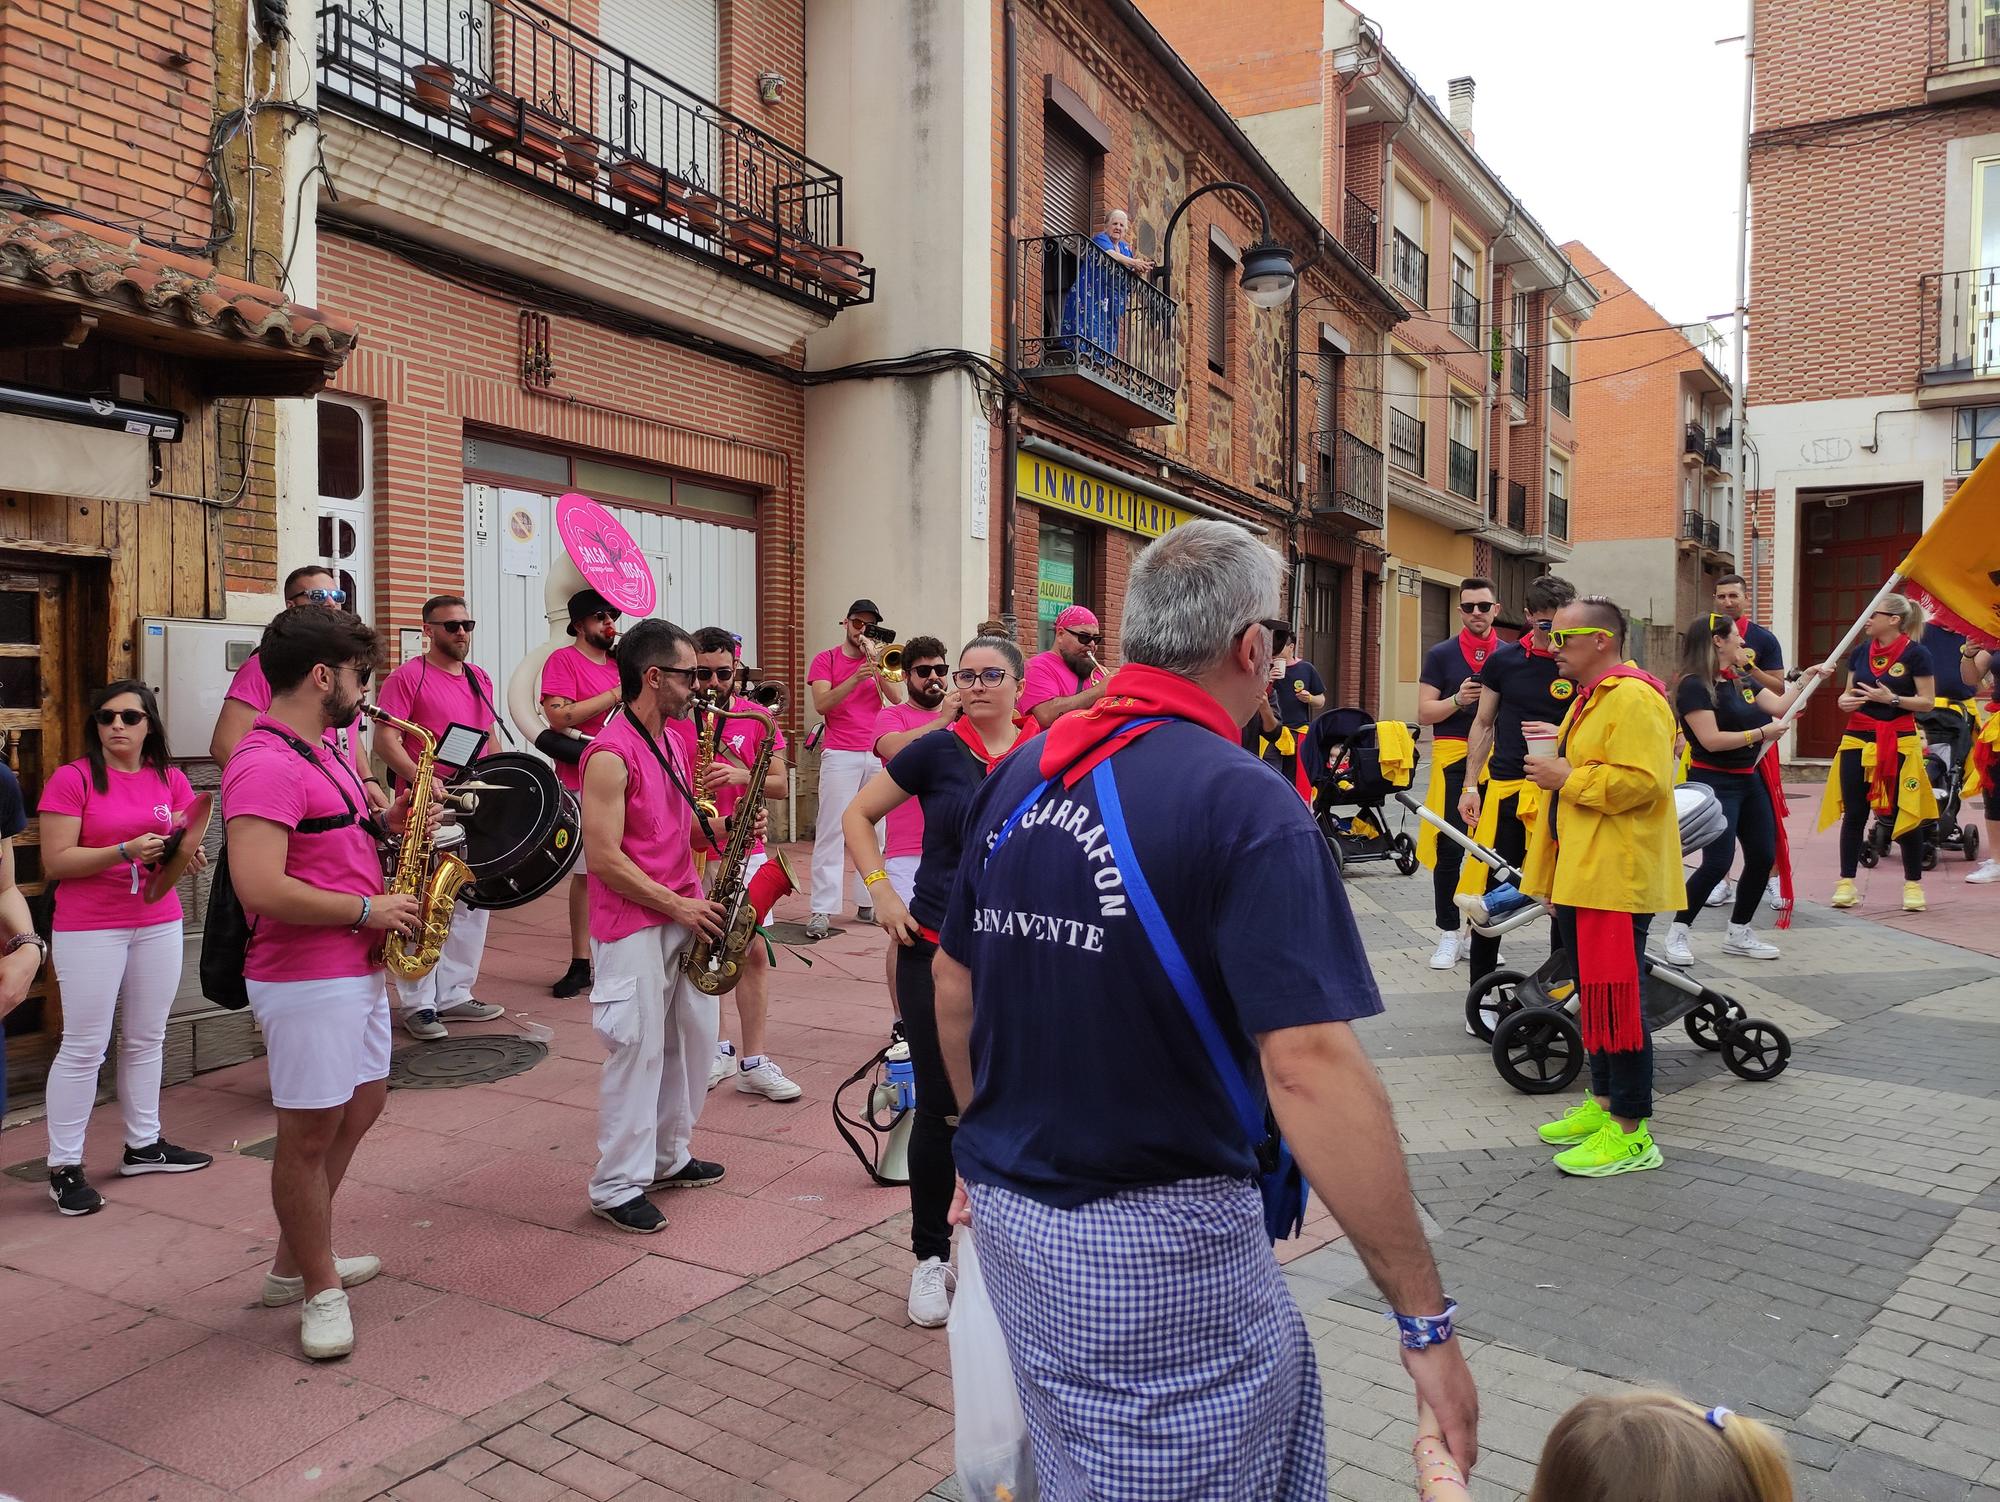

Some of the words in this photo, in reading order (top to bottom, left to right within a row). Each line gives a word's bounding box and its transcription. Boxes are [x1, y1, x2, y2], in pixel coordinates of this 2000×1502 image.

[1034, 462, 1177, 533] INMOBILIARIA
[578, 545, 611, 565] SALSA
[618, 561, 643, 579] ROSA
[1039, 582, 1072, 599] ALQUILA
[1021, 799, 1127, 916] GARRAFON
[973, 908, 1105, 952] BENAVENTE
